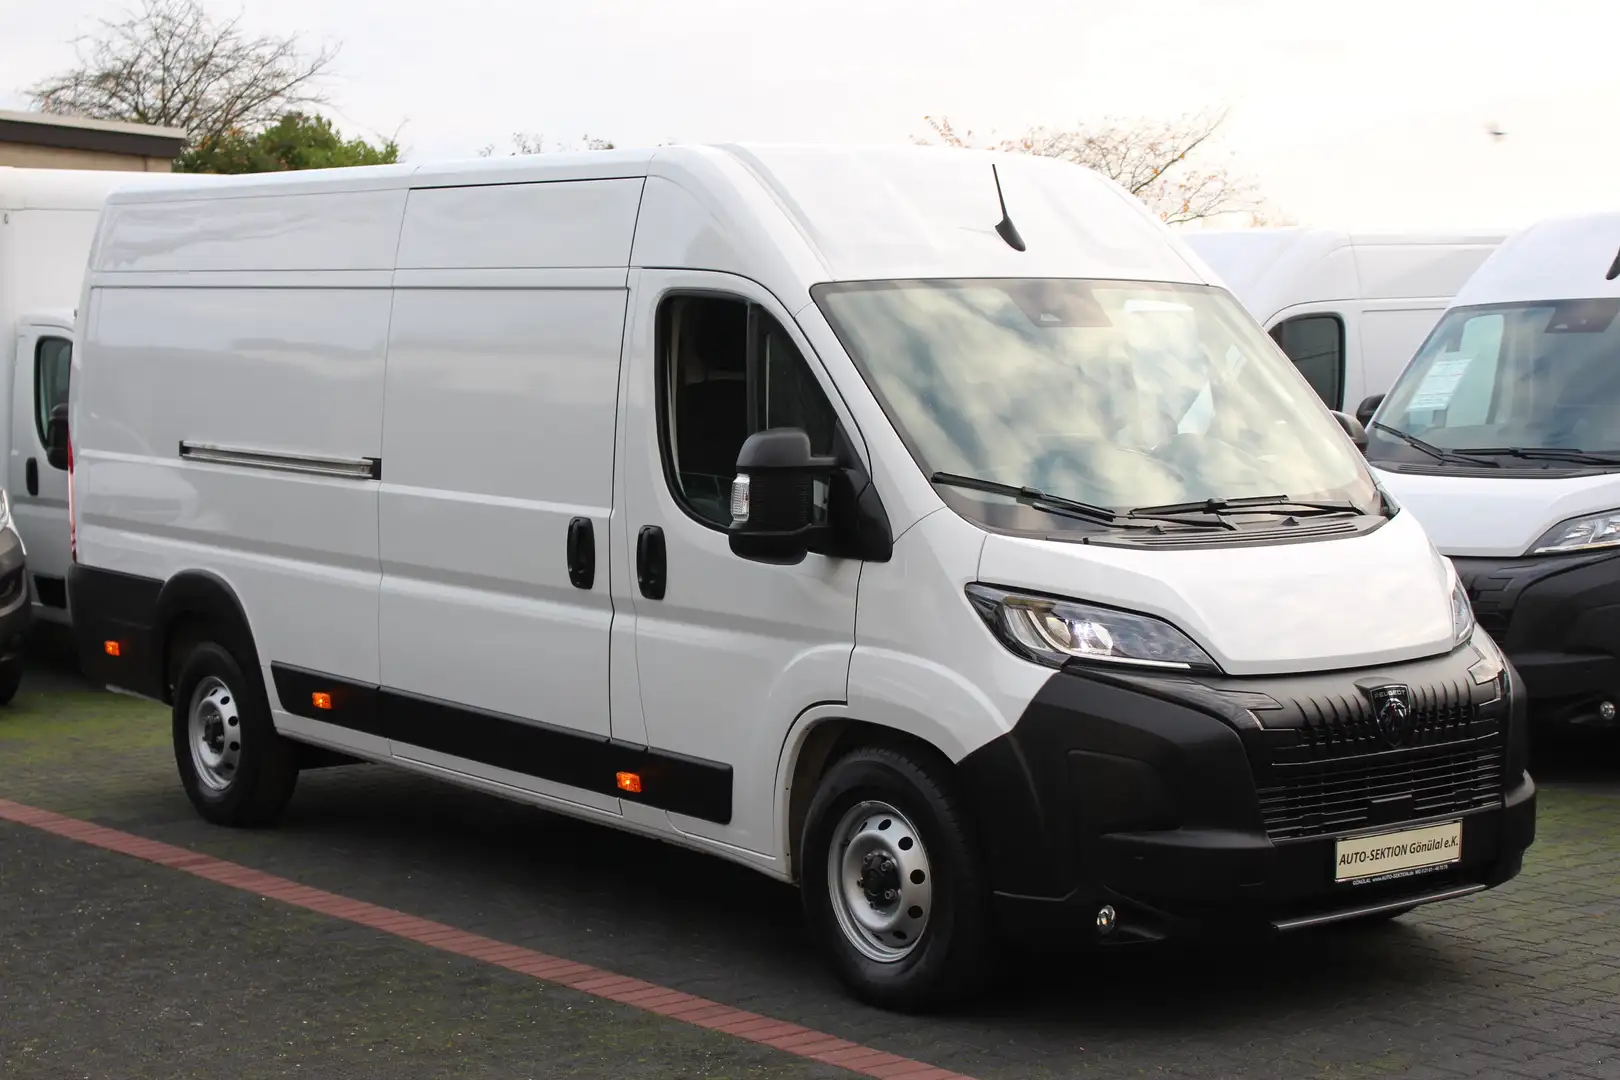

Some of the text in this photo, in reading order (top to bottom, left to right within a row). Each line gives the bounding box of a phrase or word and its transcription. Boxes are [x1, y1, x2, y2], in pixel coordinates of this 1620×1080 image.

[1338, 835, 1459, 866] AUTO-SEKTION Gönülal e.K.
